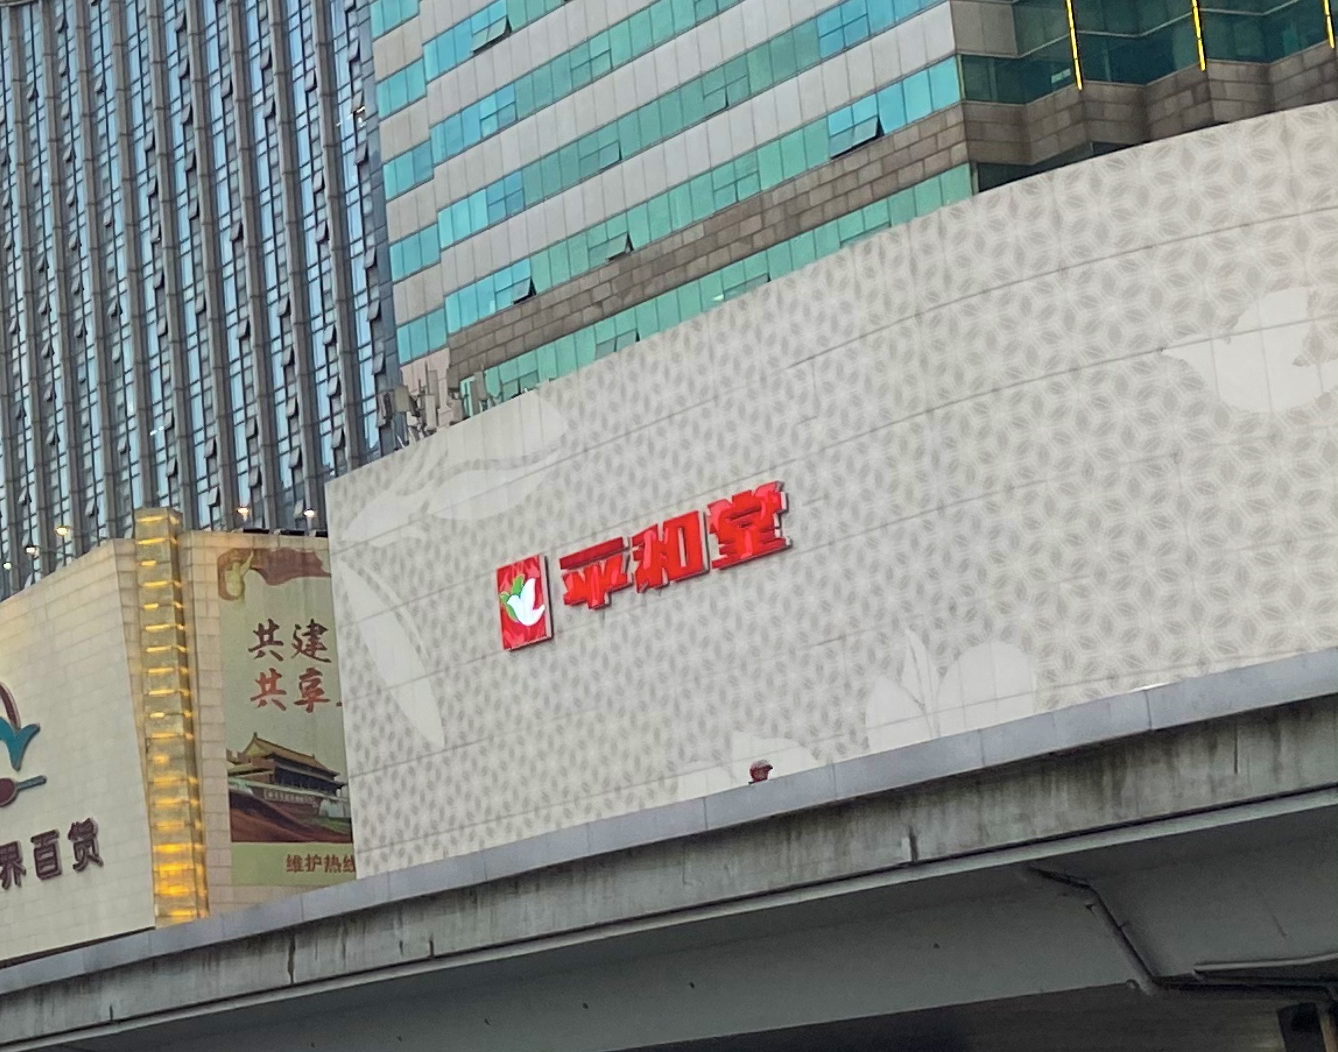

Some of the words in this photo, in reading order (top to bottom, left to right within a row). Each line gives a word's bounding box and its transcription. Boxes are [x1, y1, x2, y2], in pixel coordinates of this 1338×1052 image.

[559, 480, 792, 610] 平和堂
[248, 618, 332, 663] 共建
